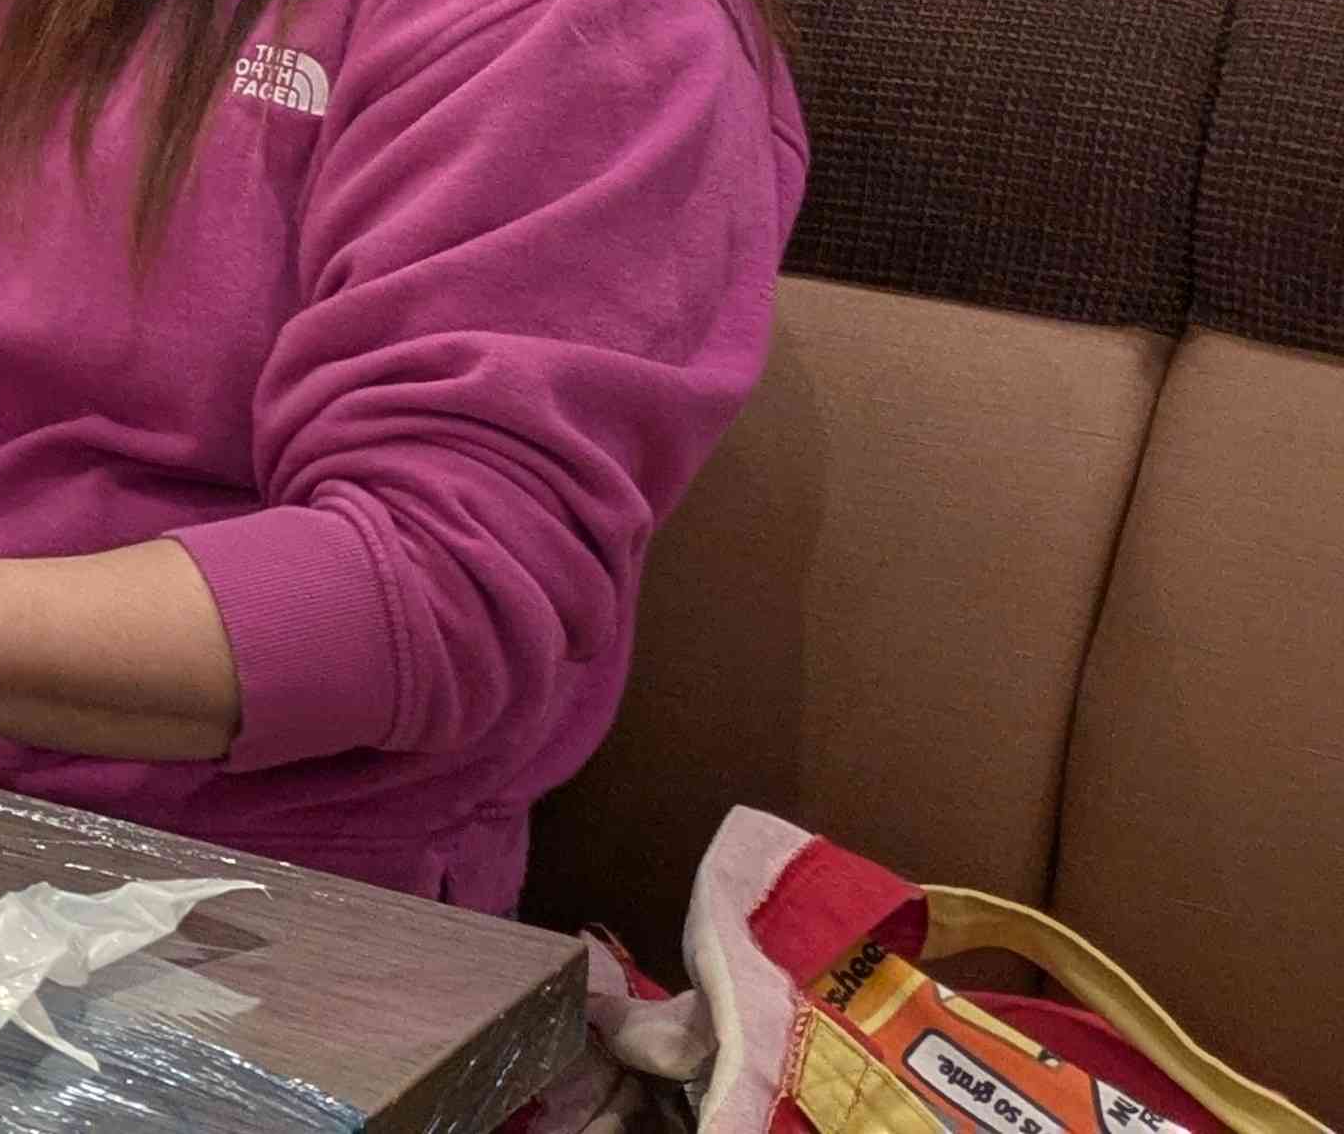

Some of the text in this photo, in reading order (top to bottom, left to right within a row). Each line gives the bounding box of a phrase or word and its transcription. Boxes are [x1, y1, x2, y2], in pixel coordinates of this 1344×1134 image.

[256, 44, 297, 68] THE
[235, 58, 292, 87] ORTH
[231, 77, 289, 106] FACE
